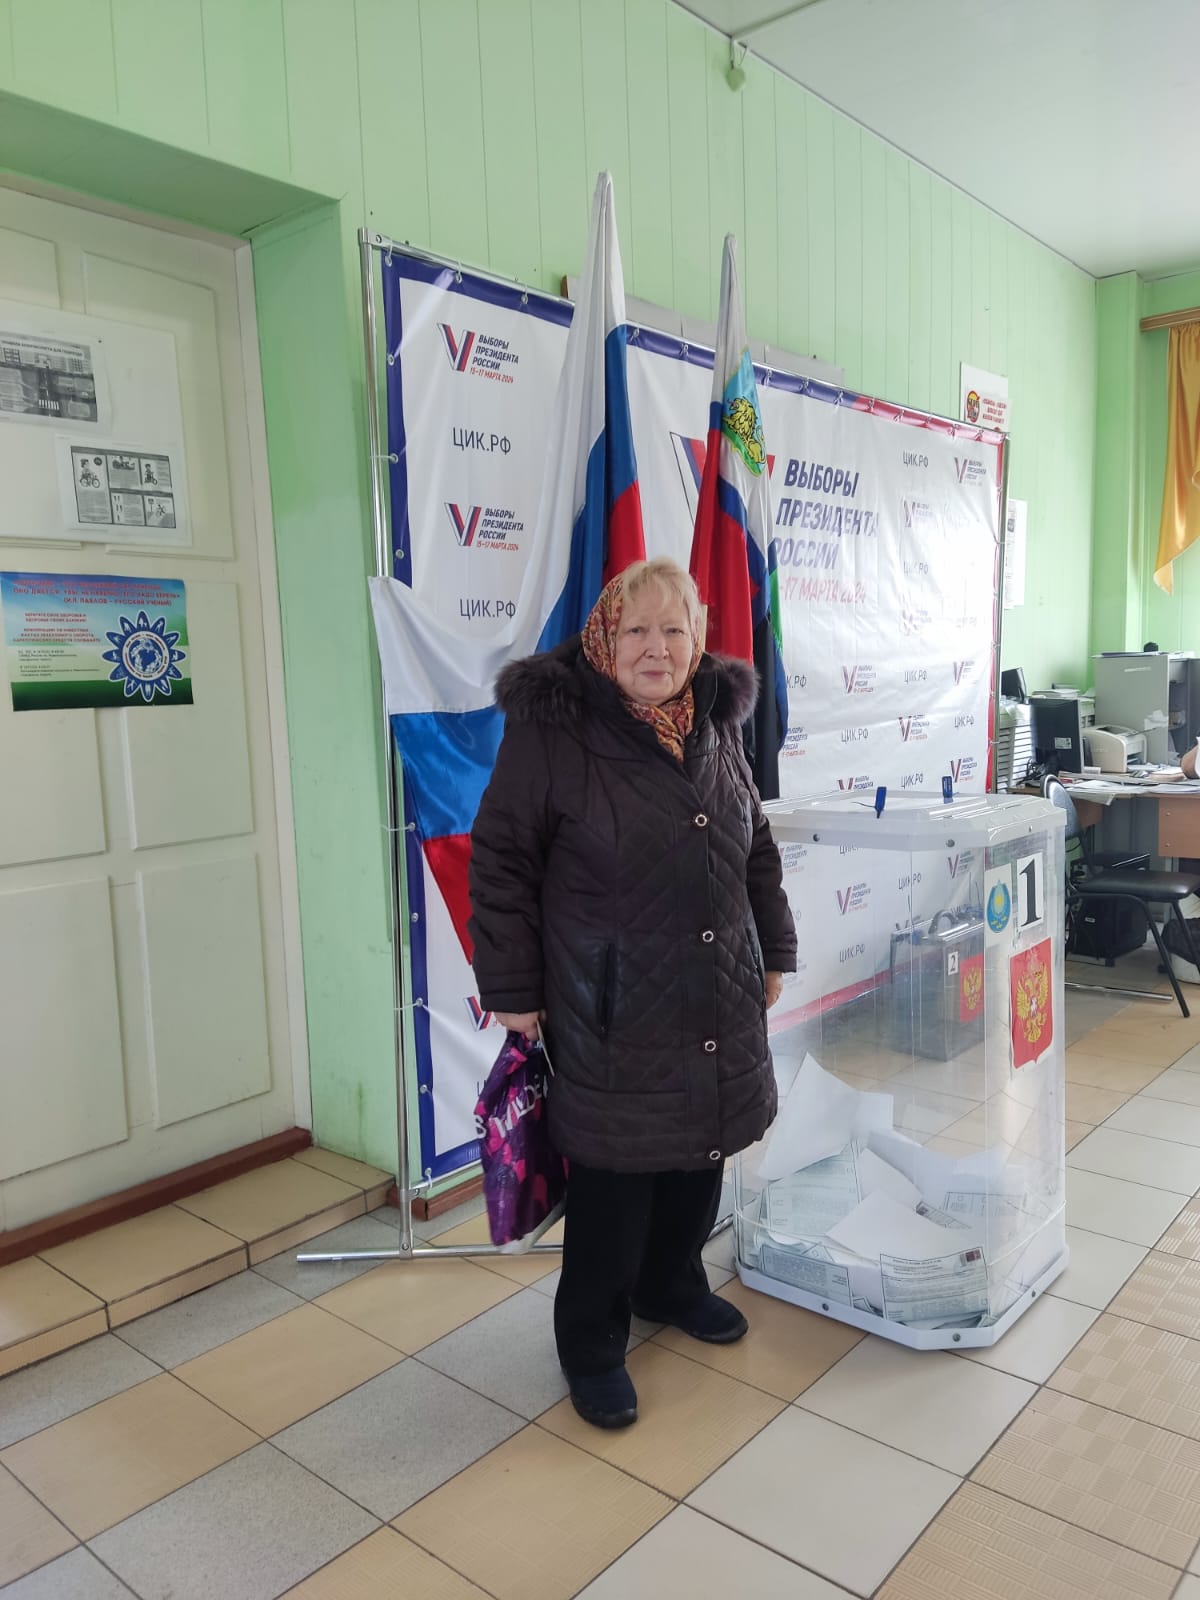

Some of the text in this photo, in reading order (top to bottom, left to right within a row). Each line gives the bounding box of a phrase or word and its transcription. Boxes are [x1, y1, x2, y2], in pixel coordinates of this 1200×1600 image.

[478, 334, 509, 350] ВЫБОРЫ
[475, 345, 519, 364] ПРЕЗИДЕНТА
[472, 356, 500, 371] РОССИИ
[453, 427, 511, 455] ЦИК.РФ
[784, 458, 859, 498] ВЫБОРЫ
[485, 508, 515, 520] ВЫБОРЫ
[776, 498, 879, 537] ПРЕЗИДЕНТА
[482, 519, 524, 532] ПРЕЗИДЕНТА
[478, 530, 506, 540] РОССИИ
[459, 598, 516, 621] ЦИК.РФ
[786, 674, 807, 689] К.РФ
[1019, 858, 1042, 927] 1
